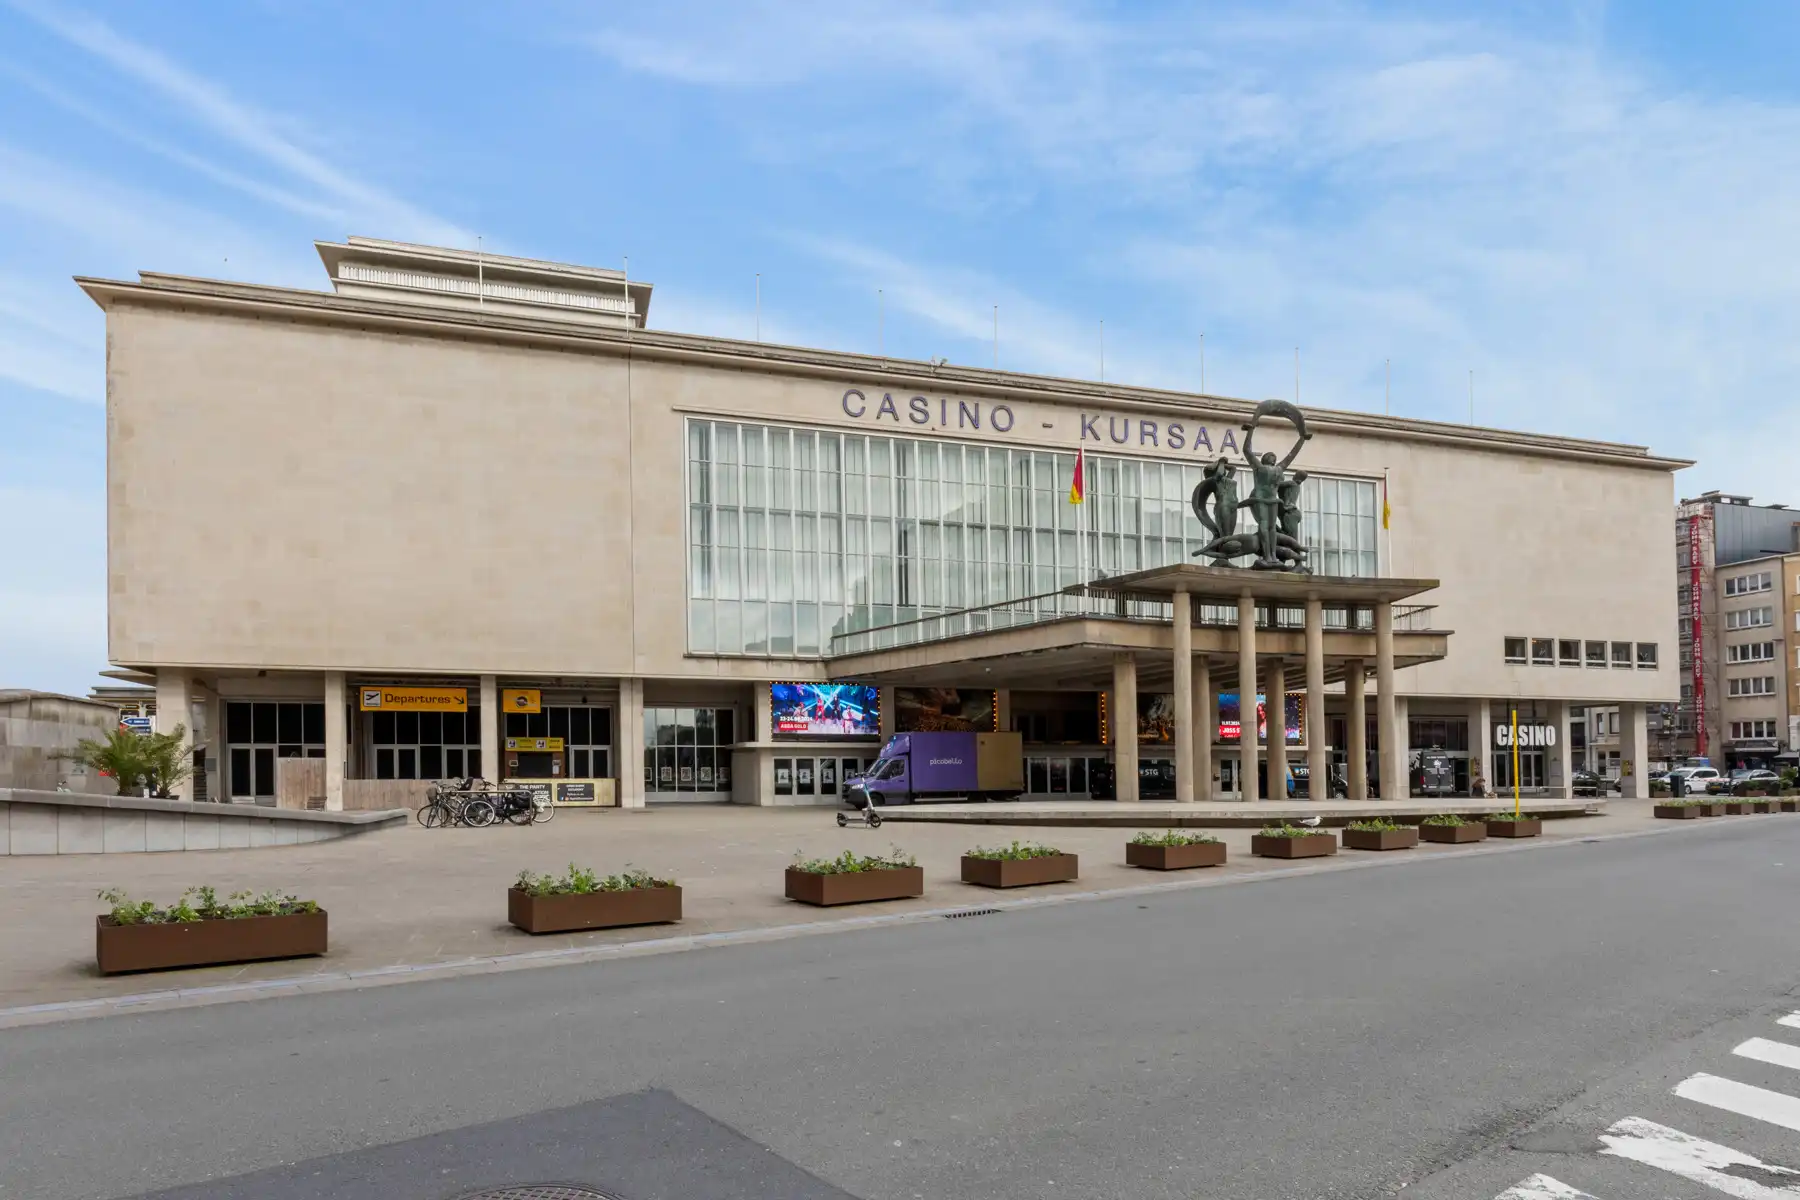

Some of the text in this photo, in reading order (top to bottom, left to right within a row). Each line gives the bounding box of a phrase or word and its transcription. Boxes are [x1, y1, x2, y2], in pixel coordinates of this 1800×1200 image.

[842, 389, 1015, 433] CASINO
[384, 693, 451, 706] Departures
[1496, 724, 1556, 746] CASINO
[929, 757, 963, 766] picobello
[1144, 768, 1159, 776] STG
